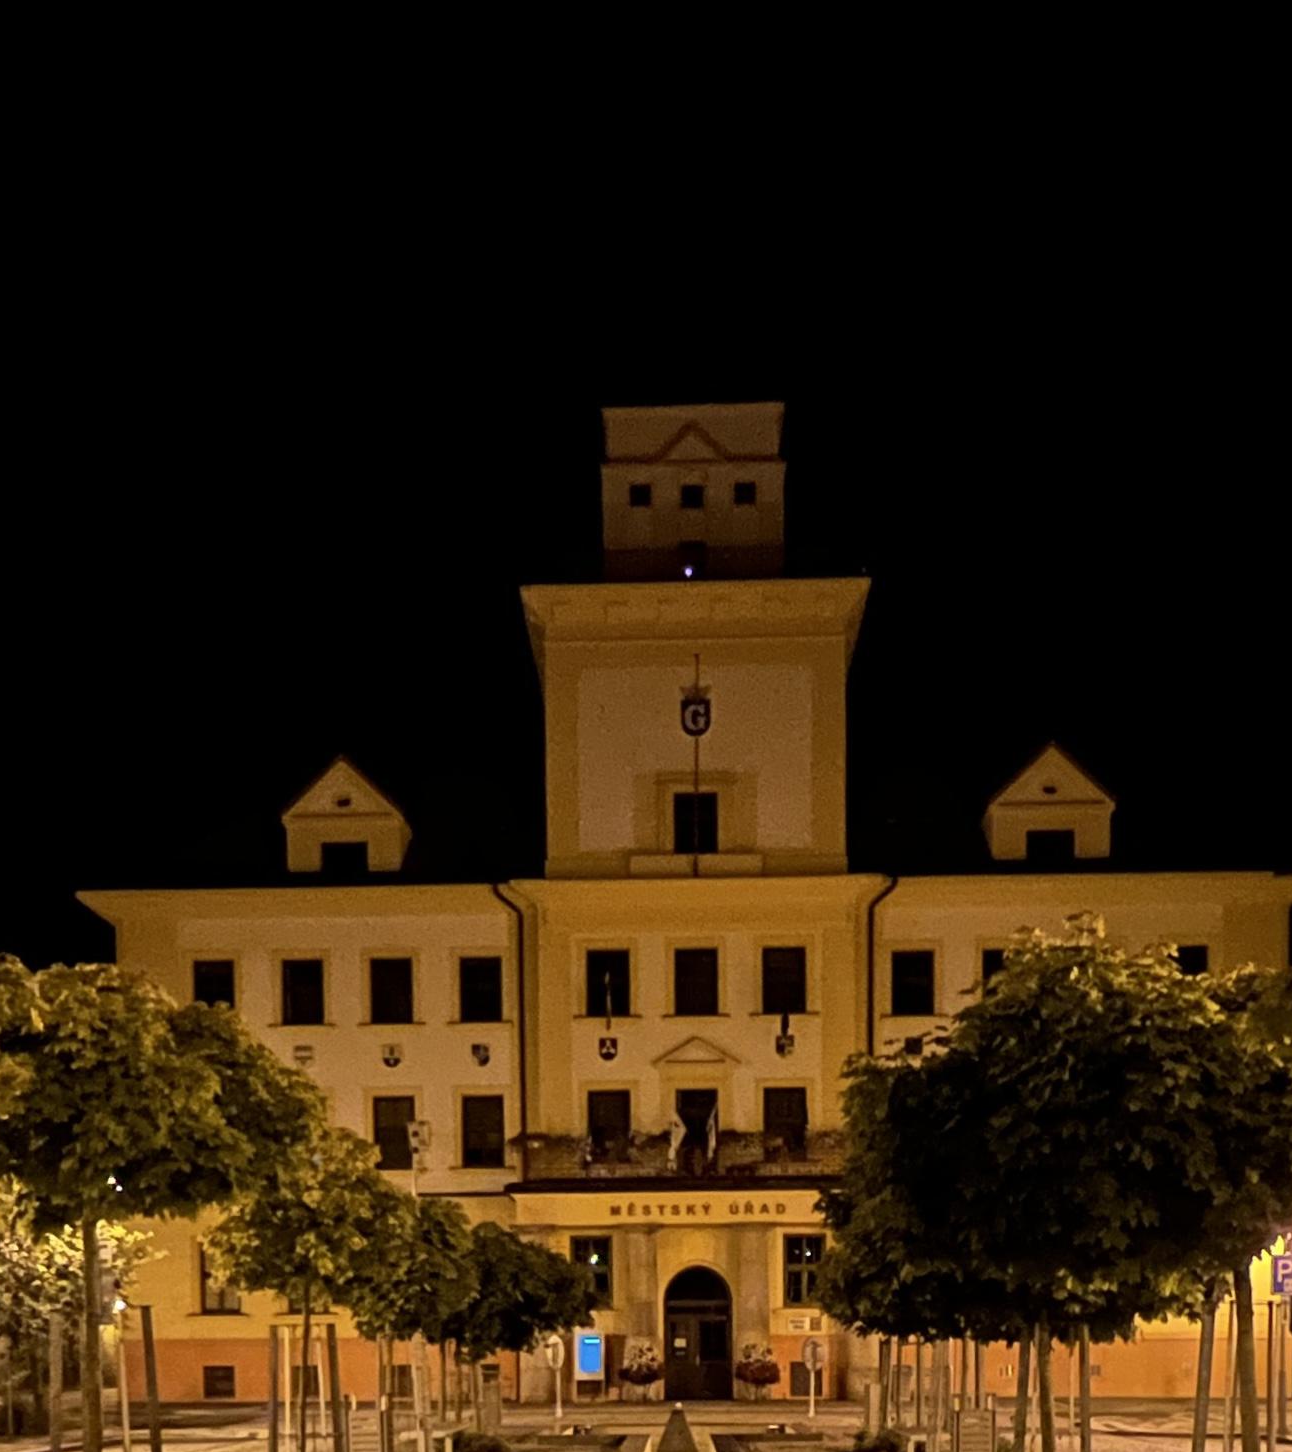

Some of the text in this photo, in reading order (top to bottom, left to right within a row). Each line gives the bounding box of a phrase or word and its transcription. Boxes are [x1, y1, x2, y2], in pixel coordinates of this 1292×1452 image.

[685, 704, 706, 730] G
[610, 1201, 786, 1216] MĚSTSKÝ ÚŘAD
